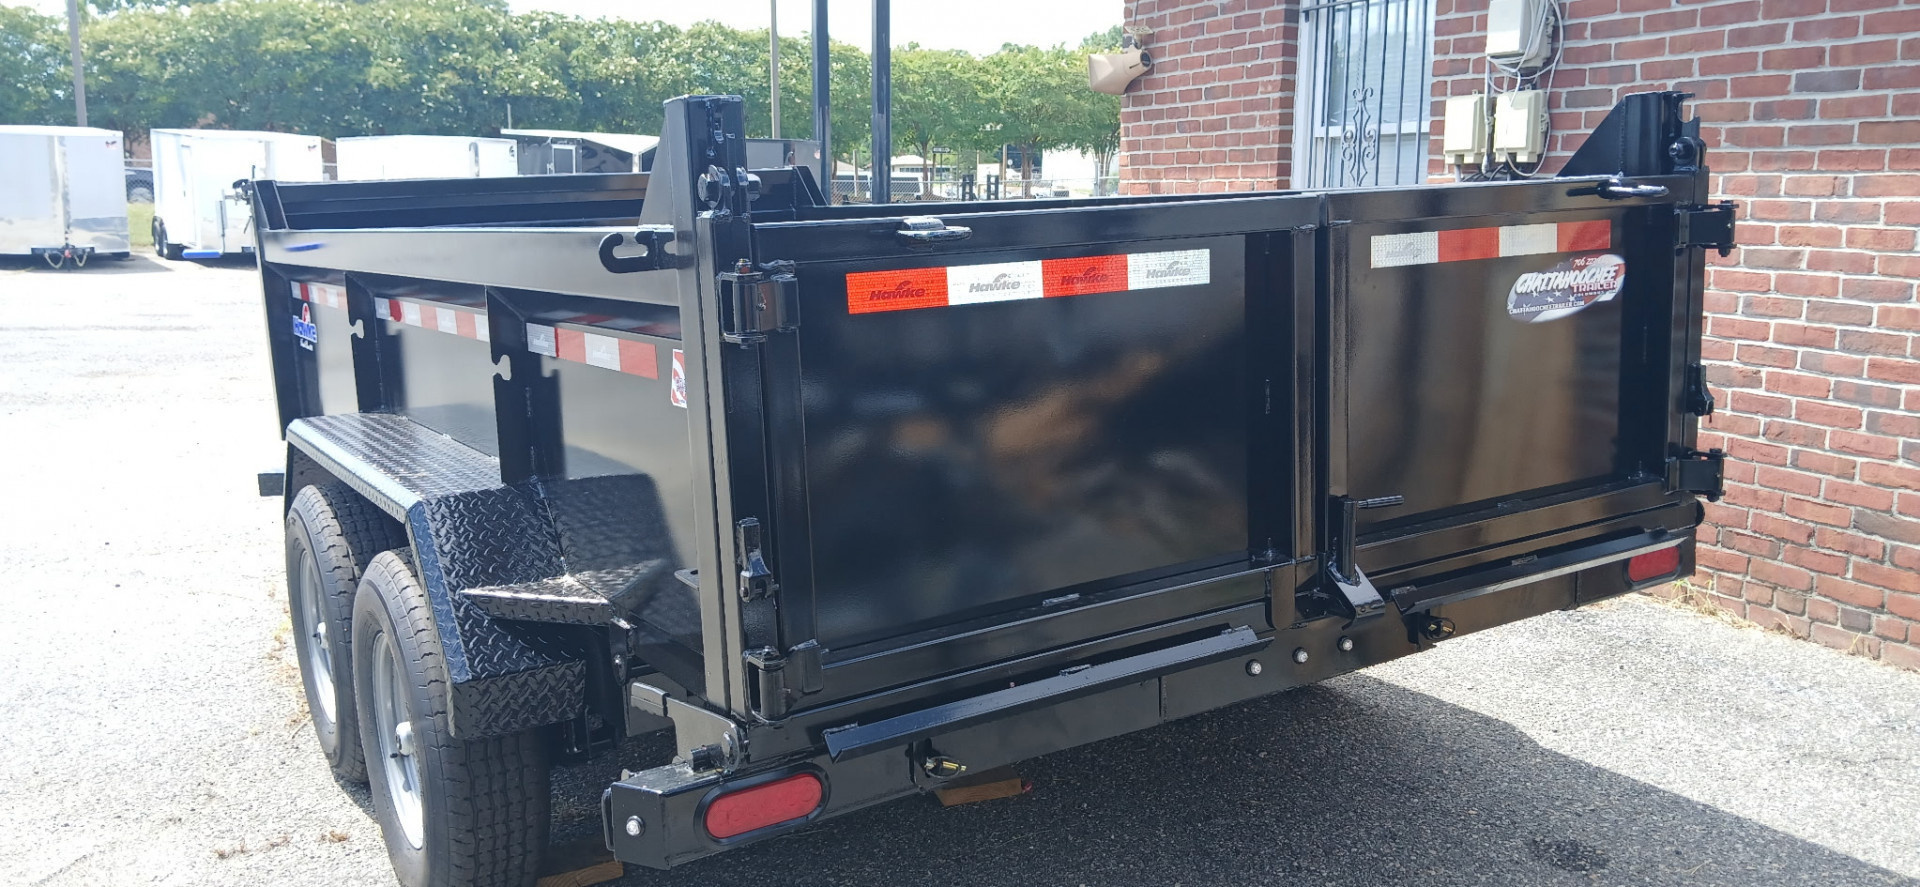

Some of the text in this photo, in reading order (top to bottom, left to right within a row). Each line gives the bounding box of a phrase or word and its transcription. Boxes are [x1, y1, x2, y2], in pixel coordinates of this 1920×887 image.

[1060, 273, 1109, 286] Hawke
[1145, 267, 1191, 279] Hawke
[968, 279, 1021, 293] Hawke
[1516, 266, 1619, 294] CHATTAHOOCHEE
[1571, 280, 1618, 293] TRAILER
[869, 287, 926, 301] Hawke
